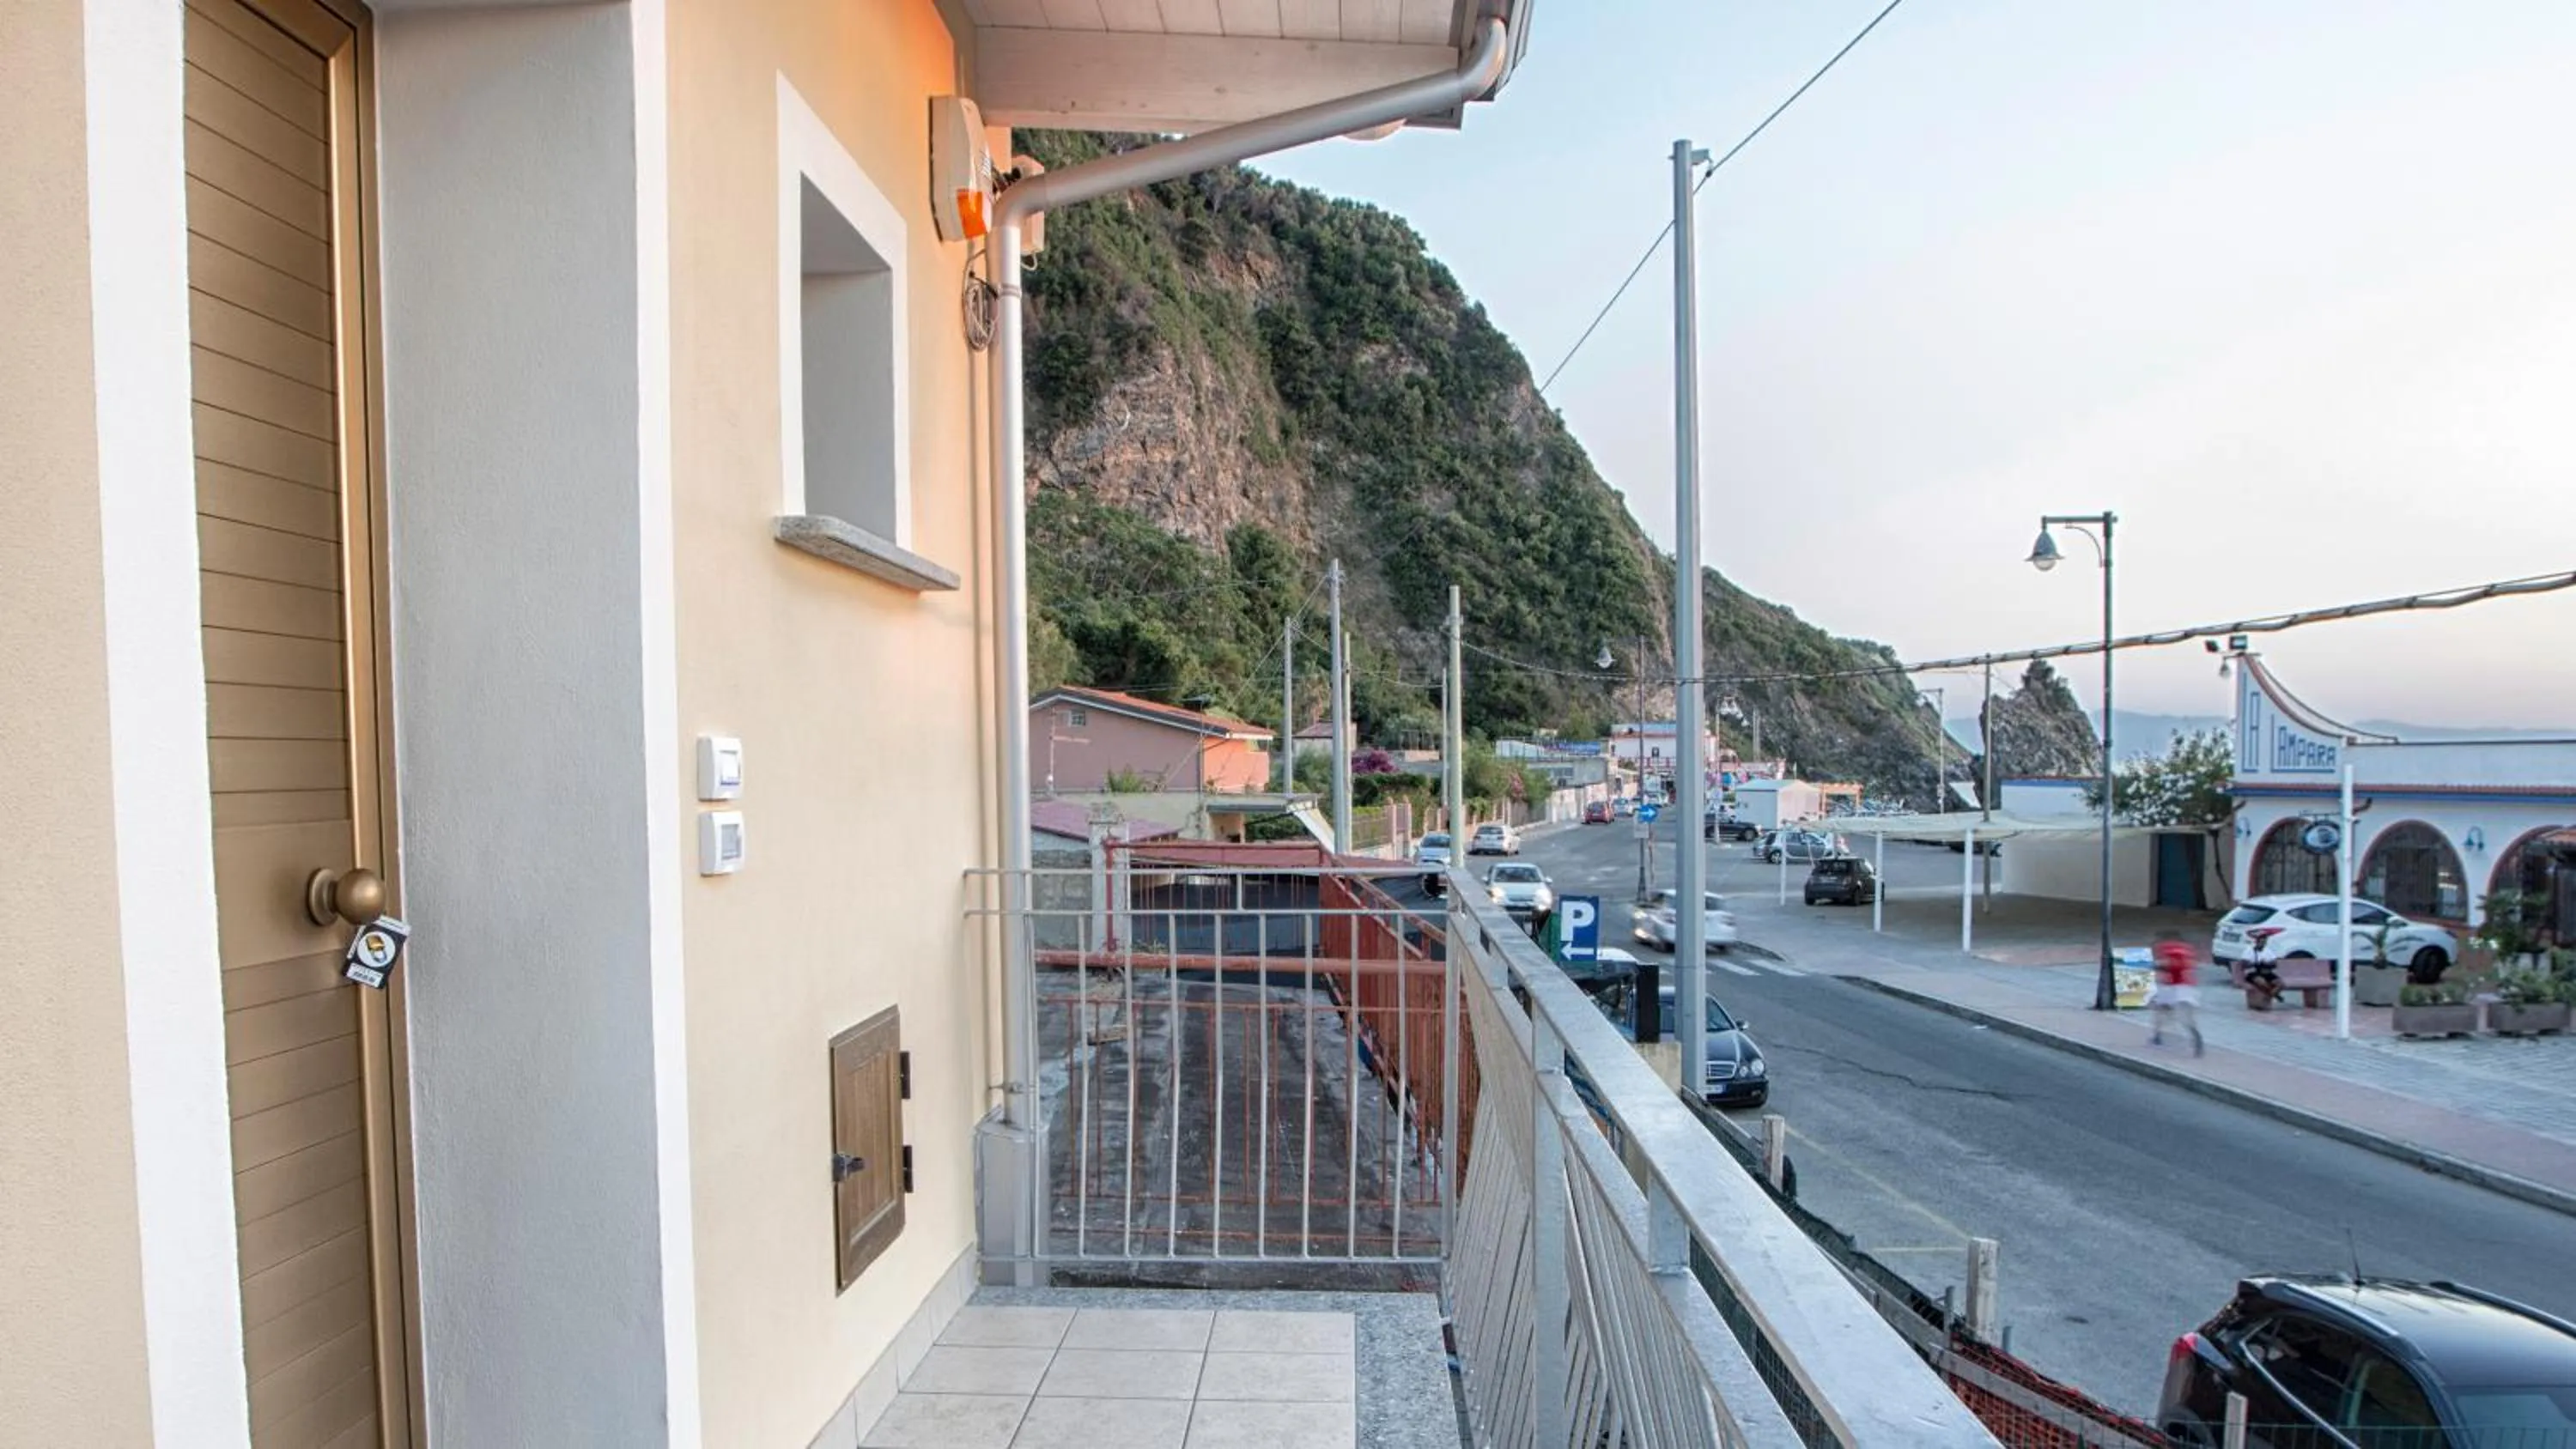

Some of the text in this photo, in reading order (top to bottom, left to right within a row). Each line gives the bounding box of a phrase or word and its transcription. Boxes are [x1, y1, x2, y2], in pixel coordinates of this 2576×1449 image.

[2241, 672, 2336, 773] LA LAMPARA
[1560, 900, 1595, 942] P
